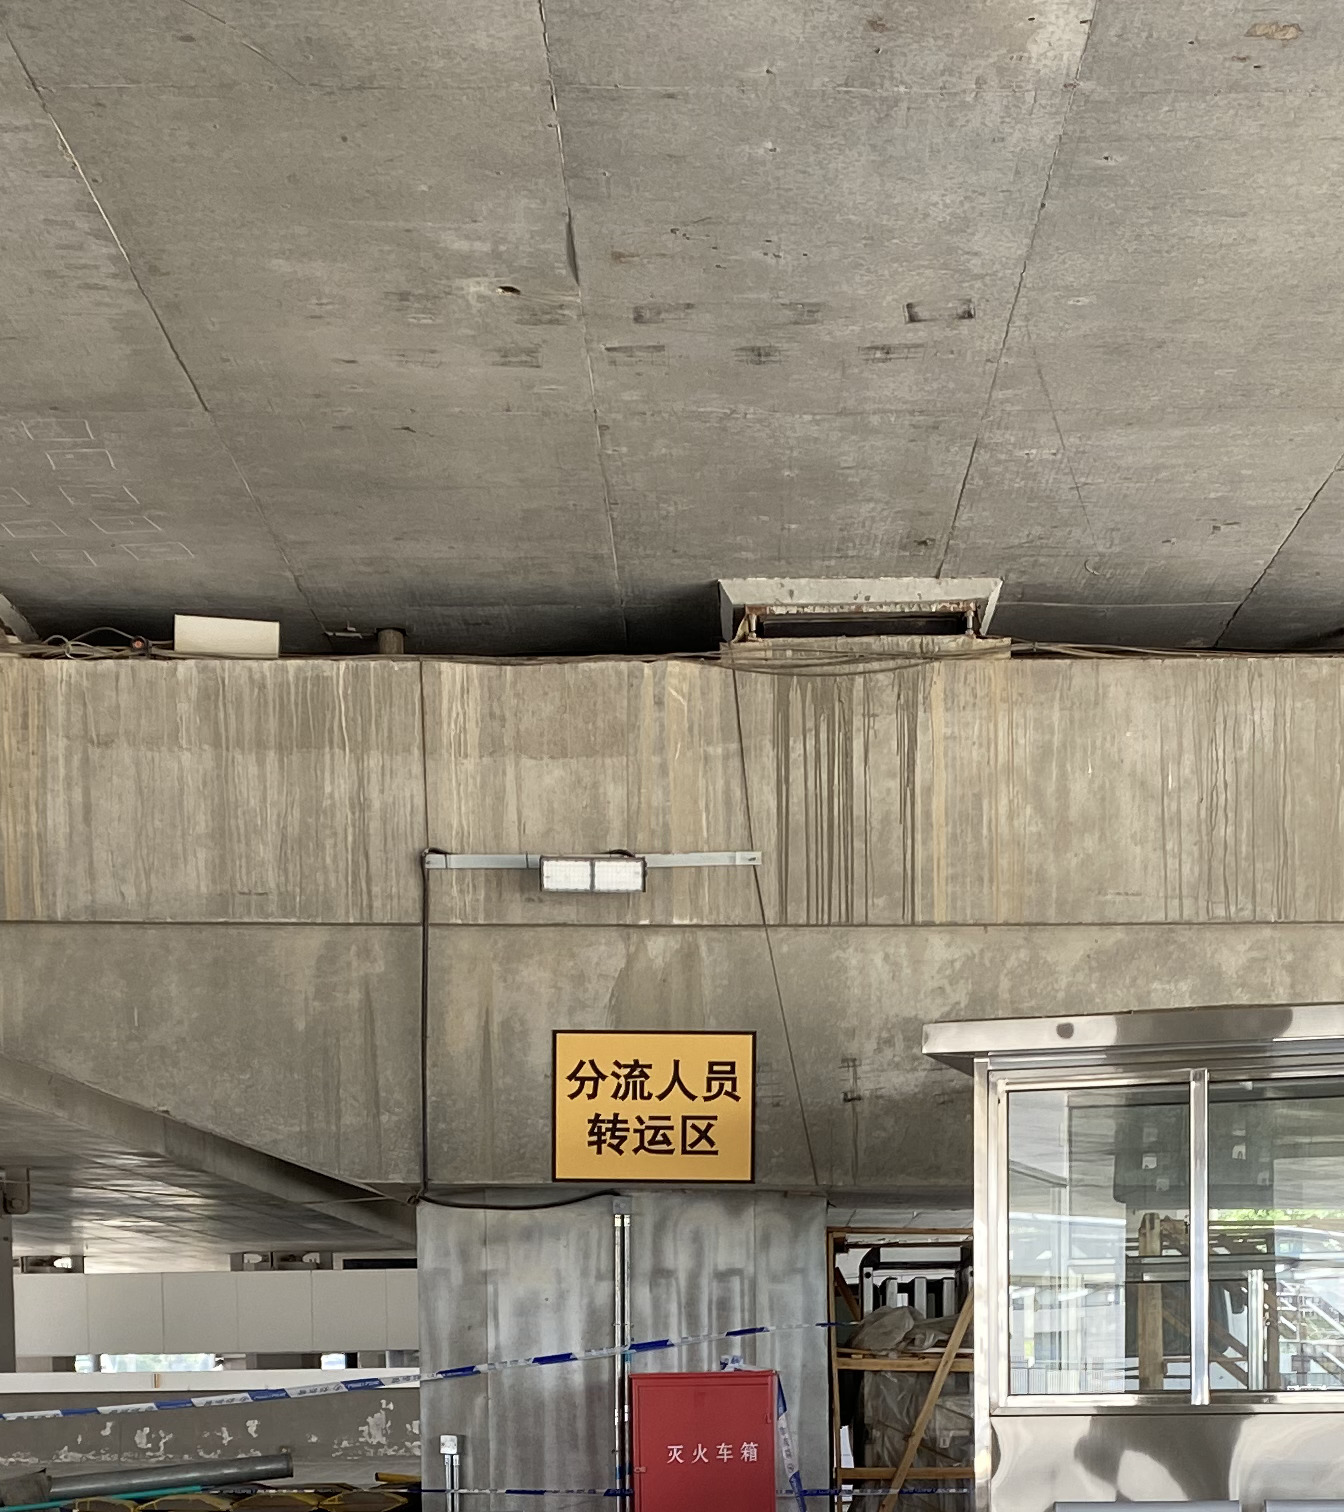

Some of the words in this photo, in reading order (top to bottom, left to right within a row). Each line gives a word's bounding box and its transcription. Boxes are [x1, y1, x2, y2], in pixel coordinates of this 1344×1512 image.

[565, 1058, 742, 1102] 分流人员
[586, 1112, 720, 1156] 转运区
[666, 1441, 759, 1464] 灭火车箱
